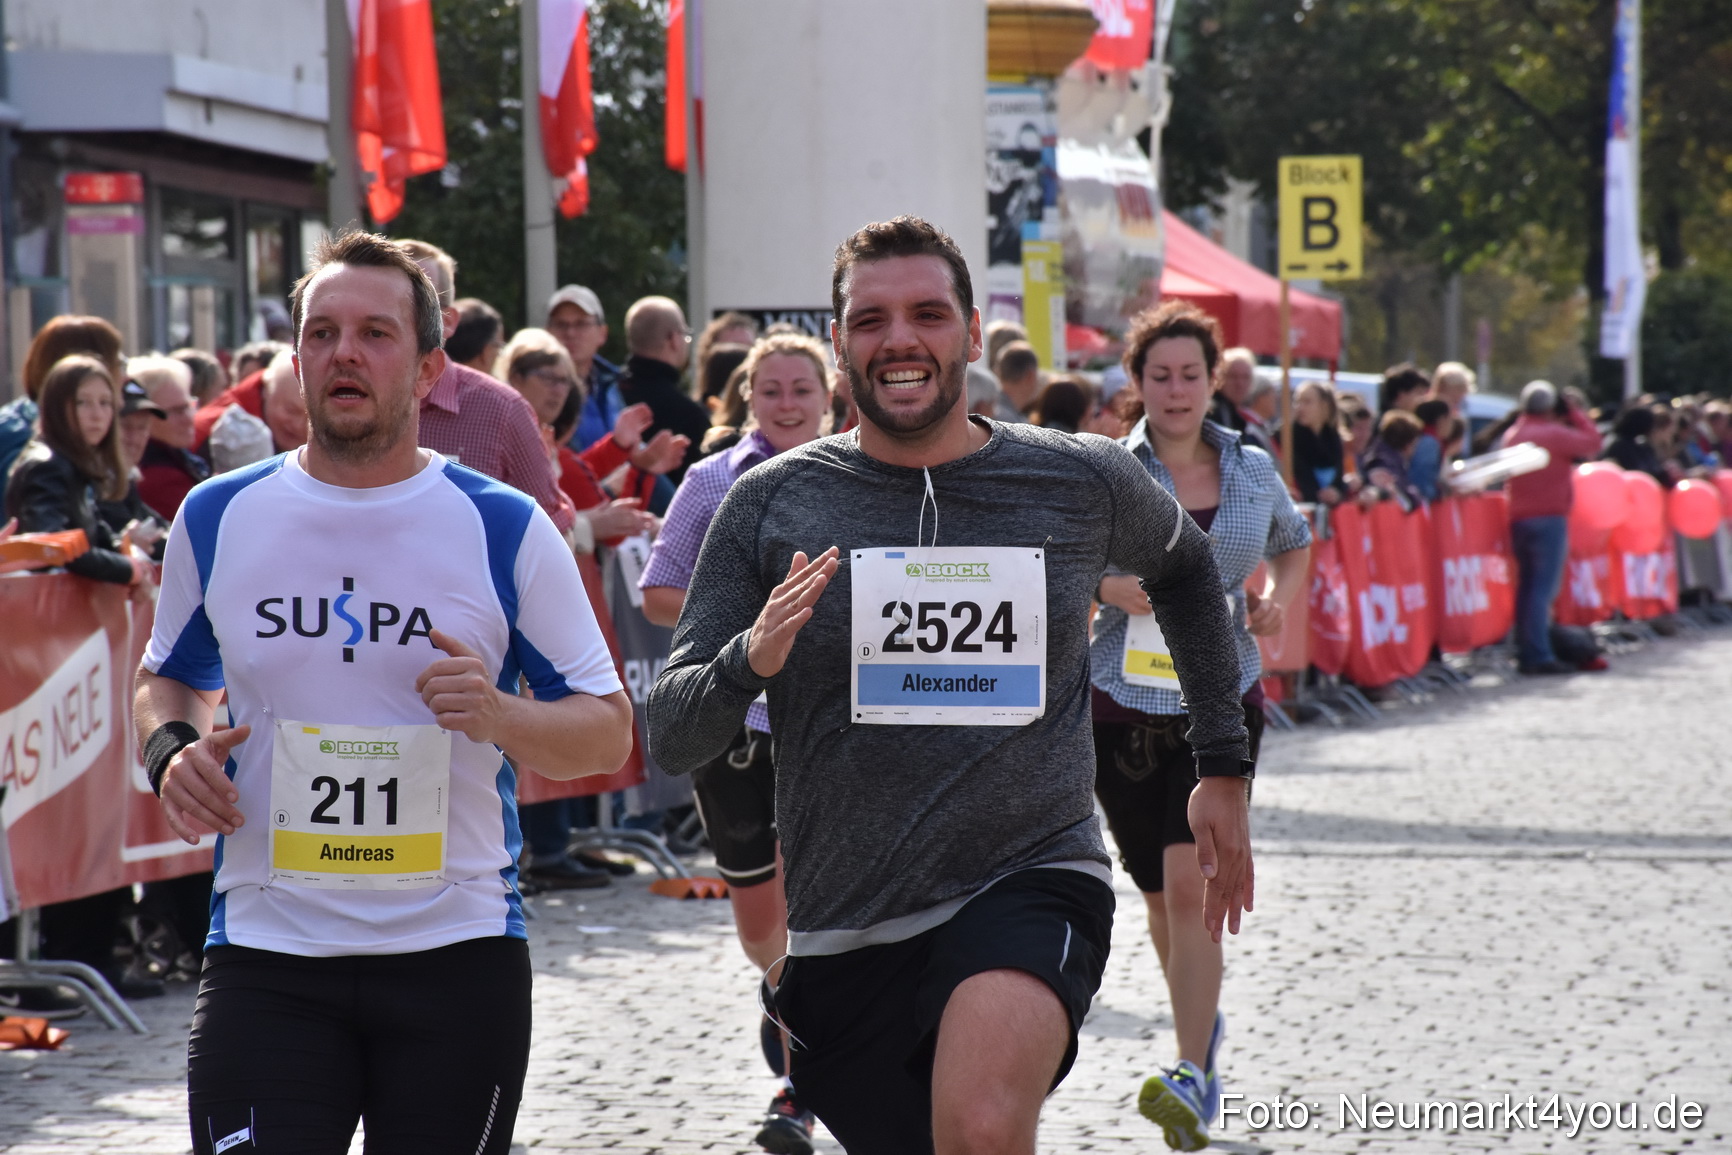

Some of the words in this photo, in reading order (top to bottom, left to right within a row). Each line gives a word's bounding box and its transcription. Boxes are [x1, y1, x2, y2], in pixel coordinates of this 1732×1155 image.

[1289, 164, 1349, 186] Block
[1302, 196, 1339, 252] B
[925, 563, 990, 577] BOCK
[255, 577, 441, 662] SUSPA
[881, 601, 1018, 653] 2524
[863, 647, 870, 656] D
[901, 673, 998, 693] Alexander
[52, 663, 102, 770] NEUE
[337, 740, 400, 755] BOCK
[310, 775, 398, 826] 211
[278, 813, 285, 823] D
[319, 843, 395, 861] Andreas
